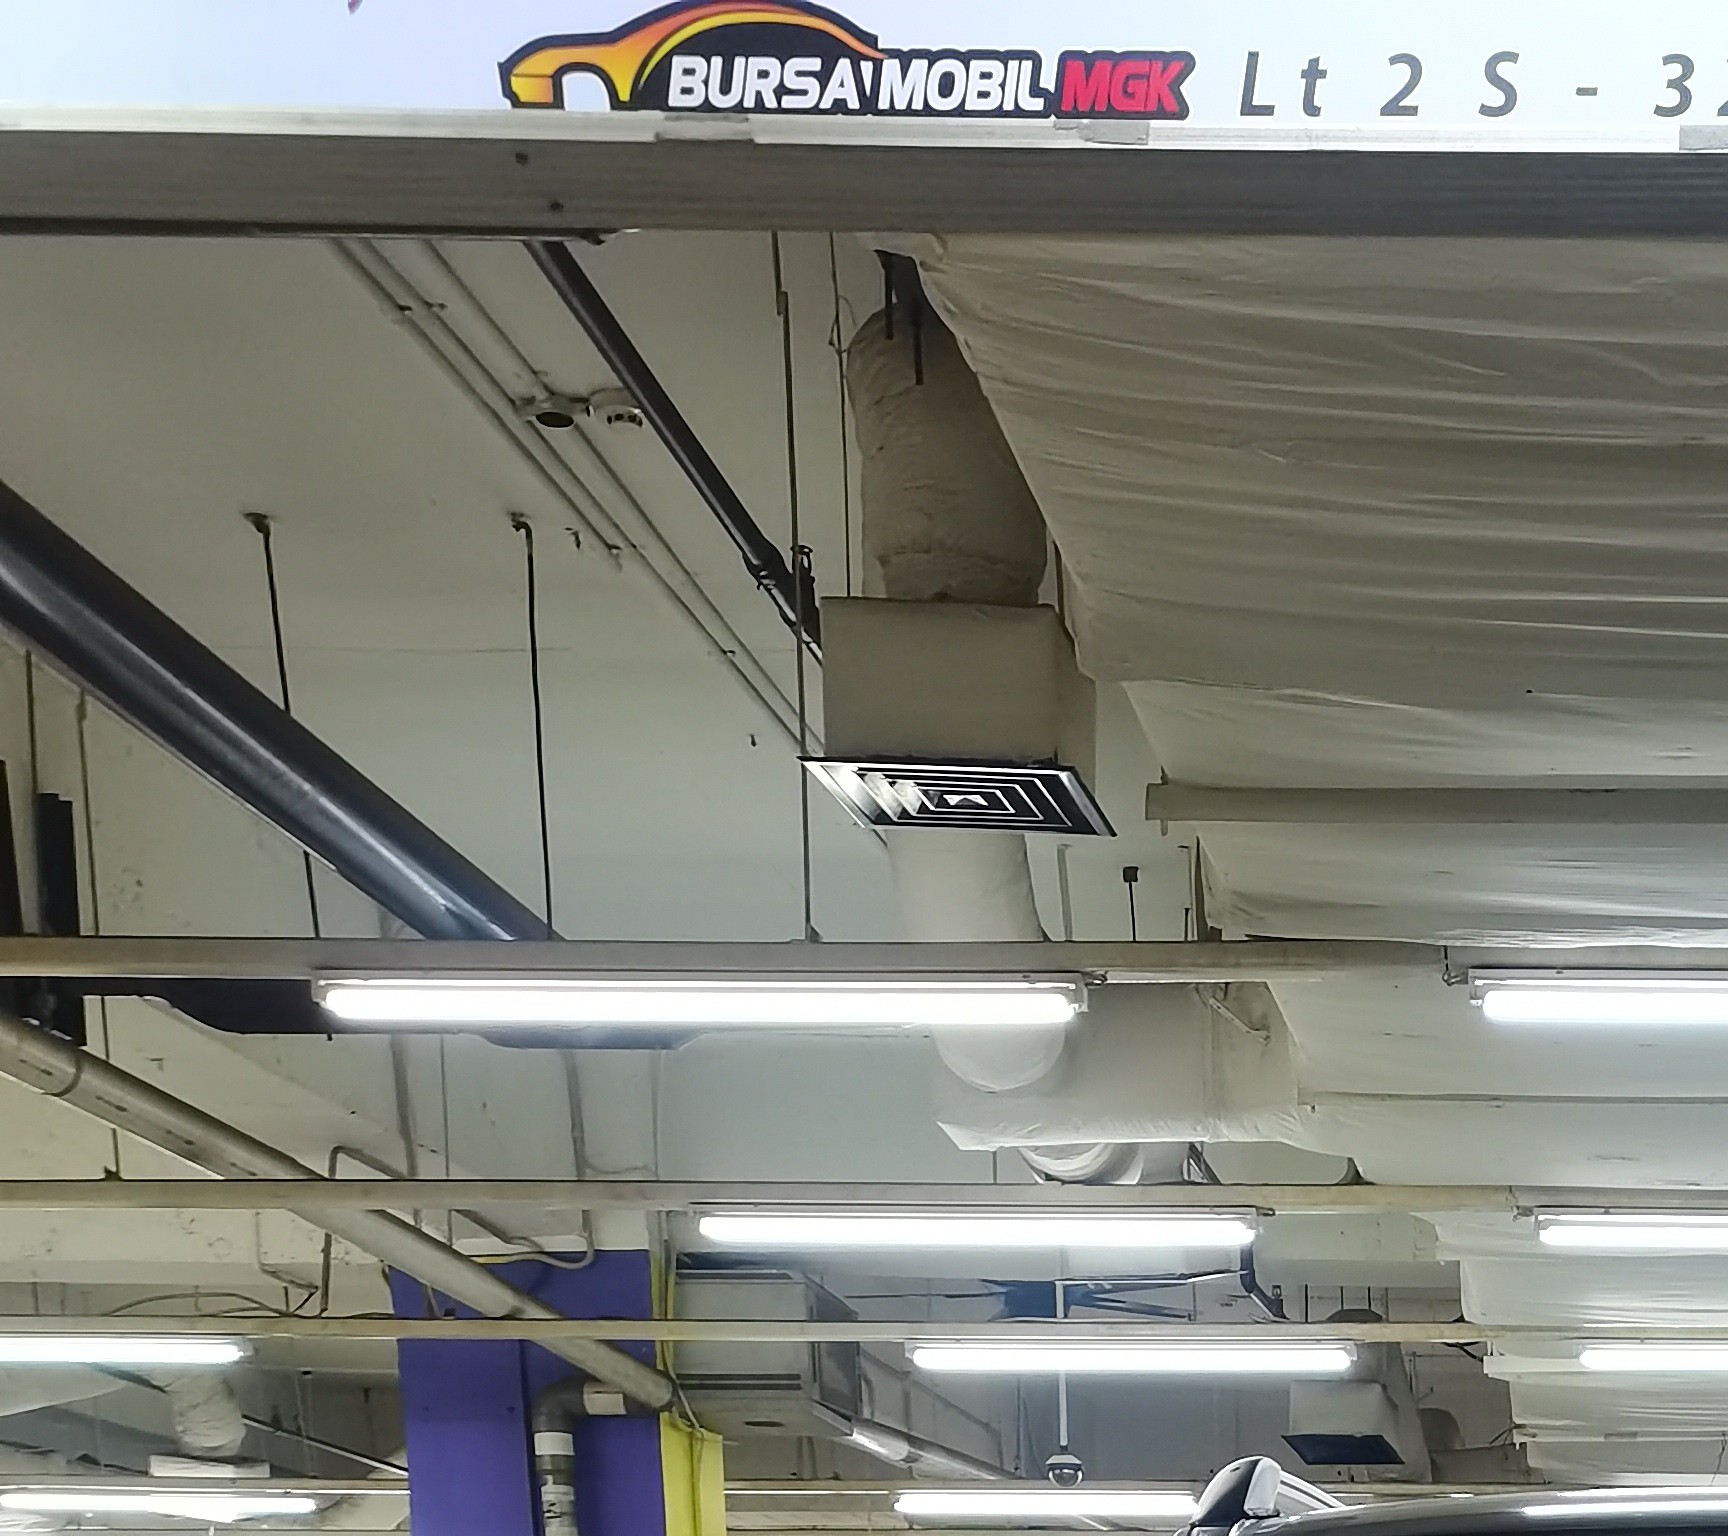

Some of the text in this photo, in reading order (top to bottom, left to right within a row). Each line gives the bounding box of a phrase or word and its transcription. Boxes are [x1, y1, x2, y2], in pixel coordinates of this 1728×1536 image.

[668, 56, 1186, 113] BURSA MOBIL MGK
[1239, 50, 1328, 117] Lt
[1379, 52, 1423, 117] 2
[1477, 51, 1520, 117] S
